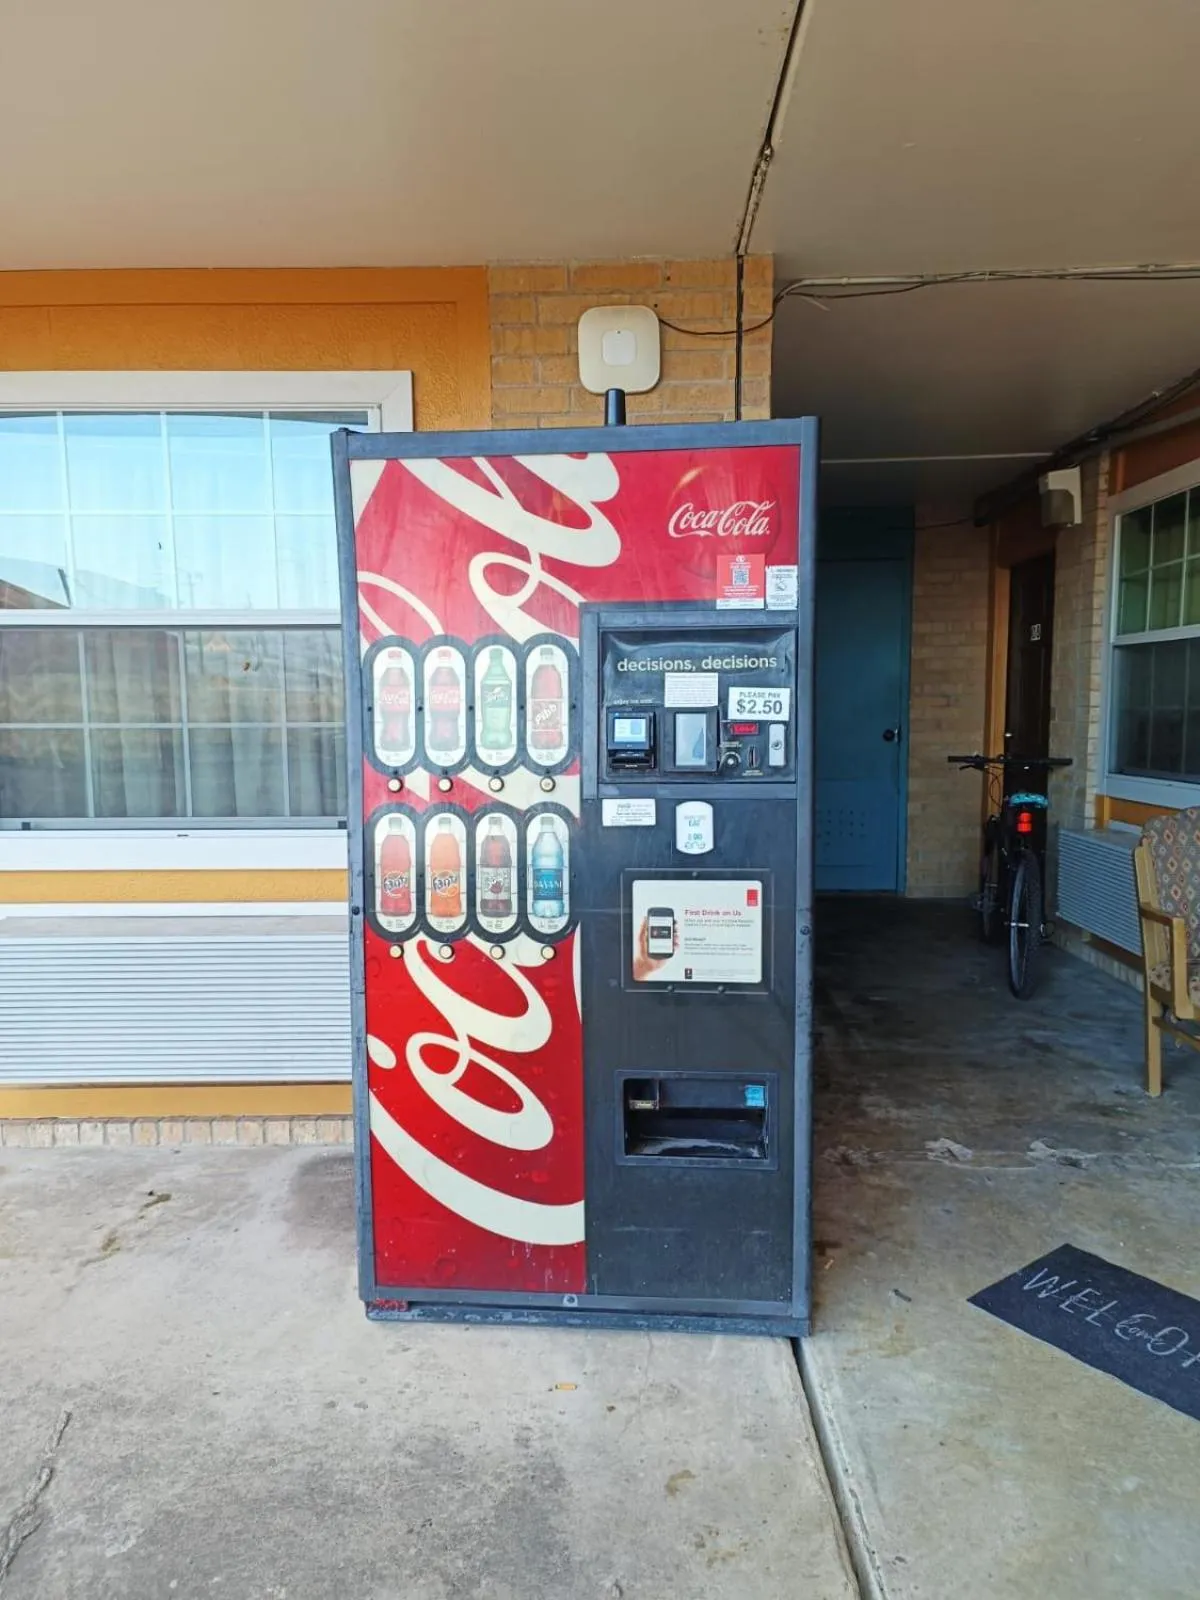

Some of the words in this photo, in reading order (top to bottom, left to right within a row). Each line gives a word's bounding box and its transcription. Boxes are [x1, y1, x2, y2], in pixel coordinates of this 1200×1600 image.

[668, 500, 776, 538] Coca-Cola
[617, 657, 696, 672] decisions,
[701, 655, 777, 671] decisions
[736, 699, 783, 715] $2.50
[1023, 1267, 1200, 1368] WELCO
